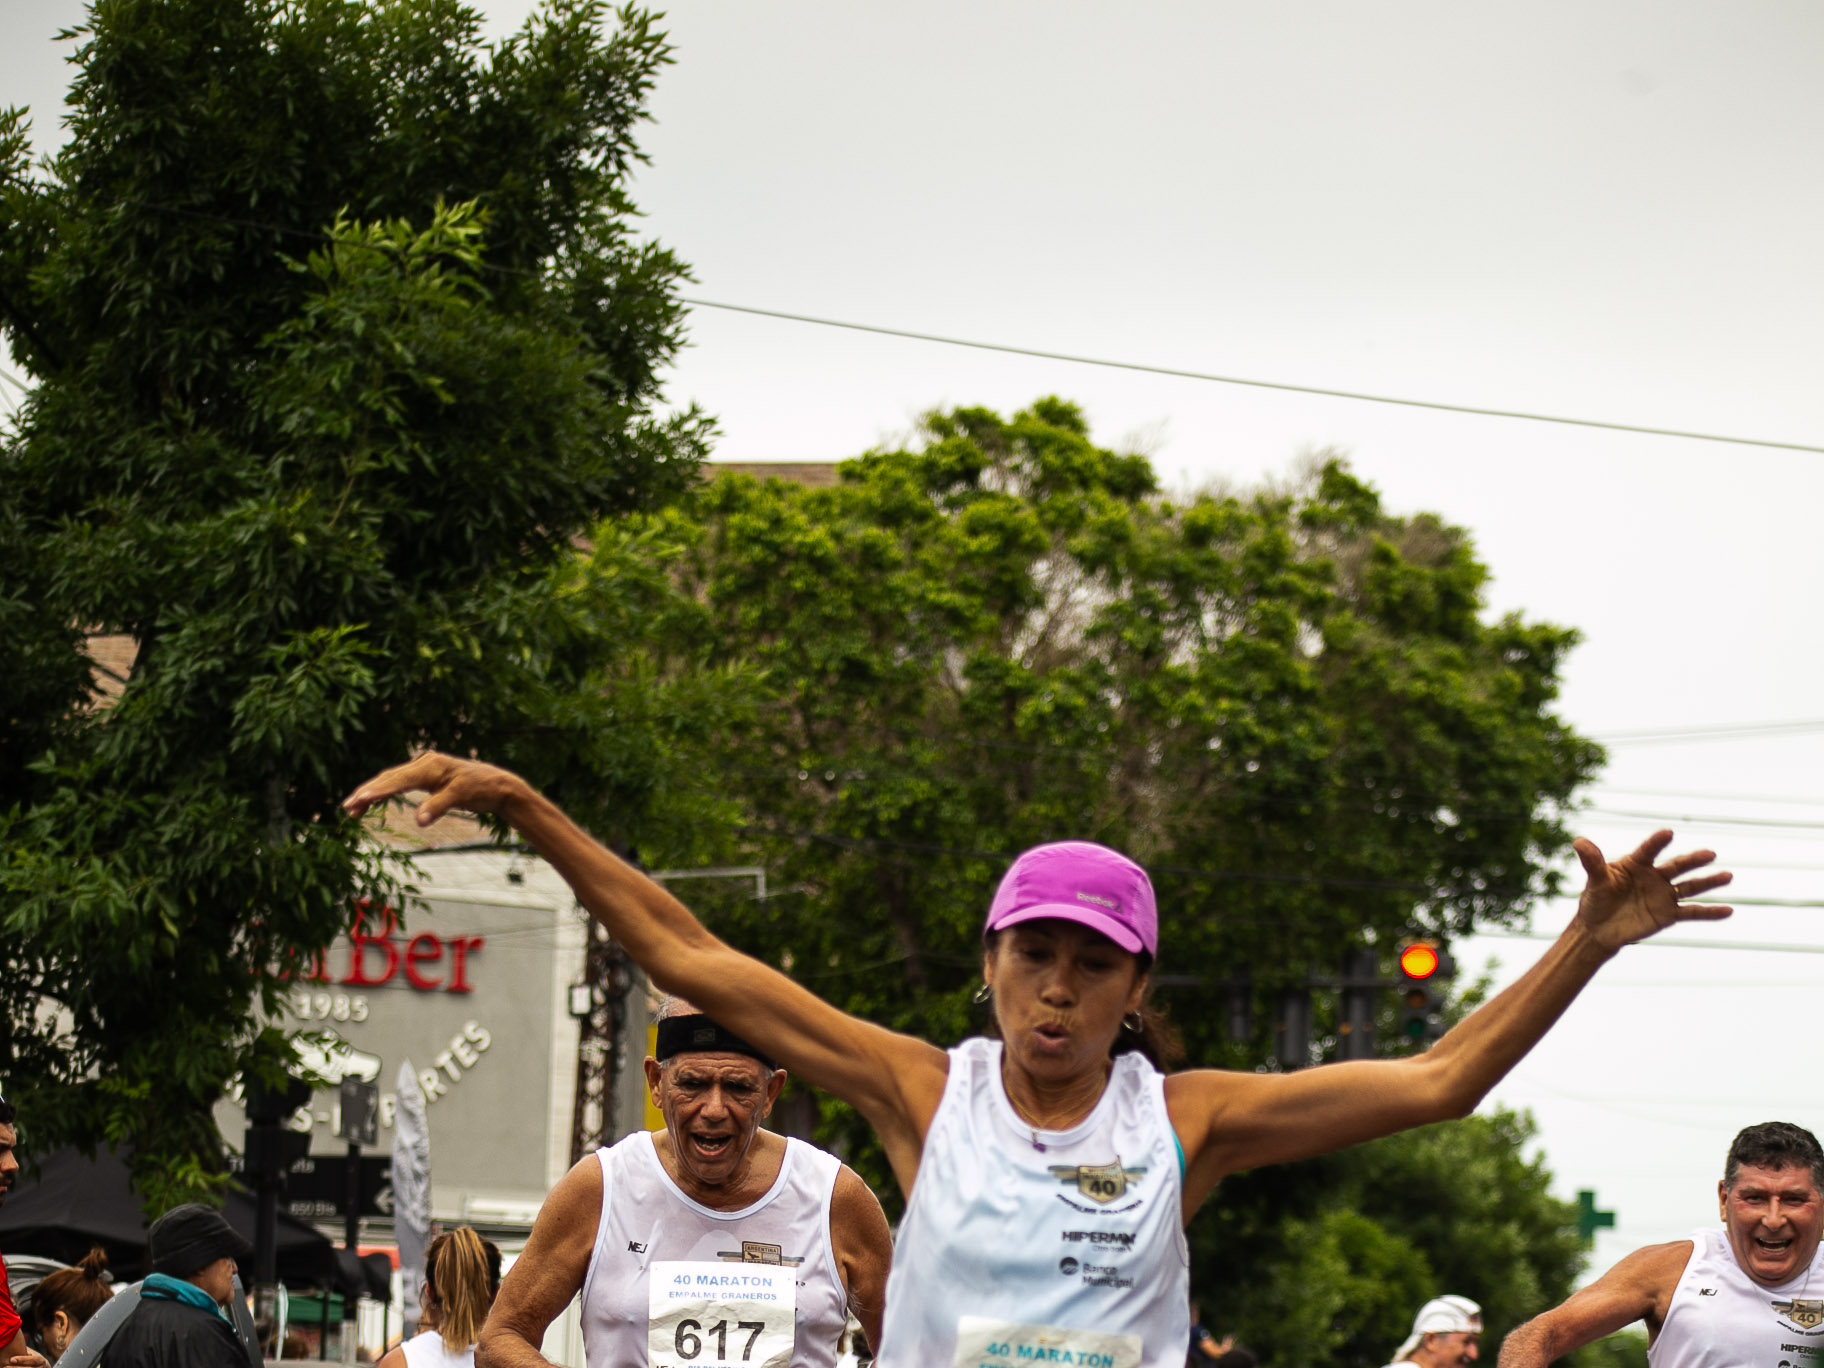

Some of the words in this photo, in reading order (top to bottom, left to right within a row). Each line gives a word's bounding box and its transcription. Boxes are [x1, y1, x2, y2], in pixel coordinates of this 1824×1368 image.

[297, 992, 370, 1023] 1985
[1089, 1180, 1116, 1196] 40
[628, 1240, 648, 1254] NEJ
[674, 1275, 691, 1285] 40
[696, 1275, 772, 1287] MARATON
[669, 1291, 717, 1299] EMPALME
[721, 1292, 777, 1300] GRANEROS
[1797, 1312, 1815, 1324] 40
[675, 1318, 765, 1361] 617
[987, 1342, 1010, 1358] 40
[1016, 1344, 1114, 1368] MARATON
